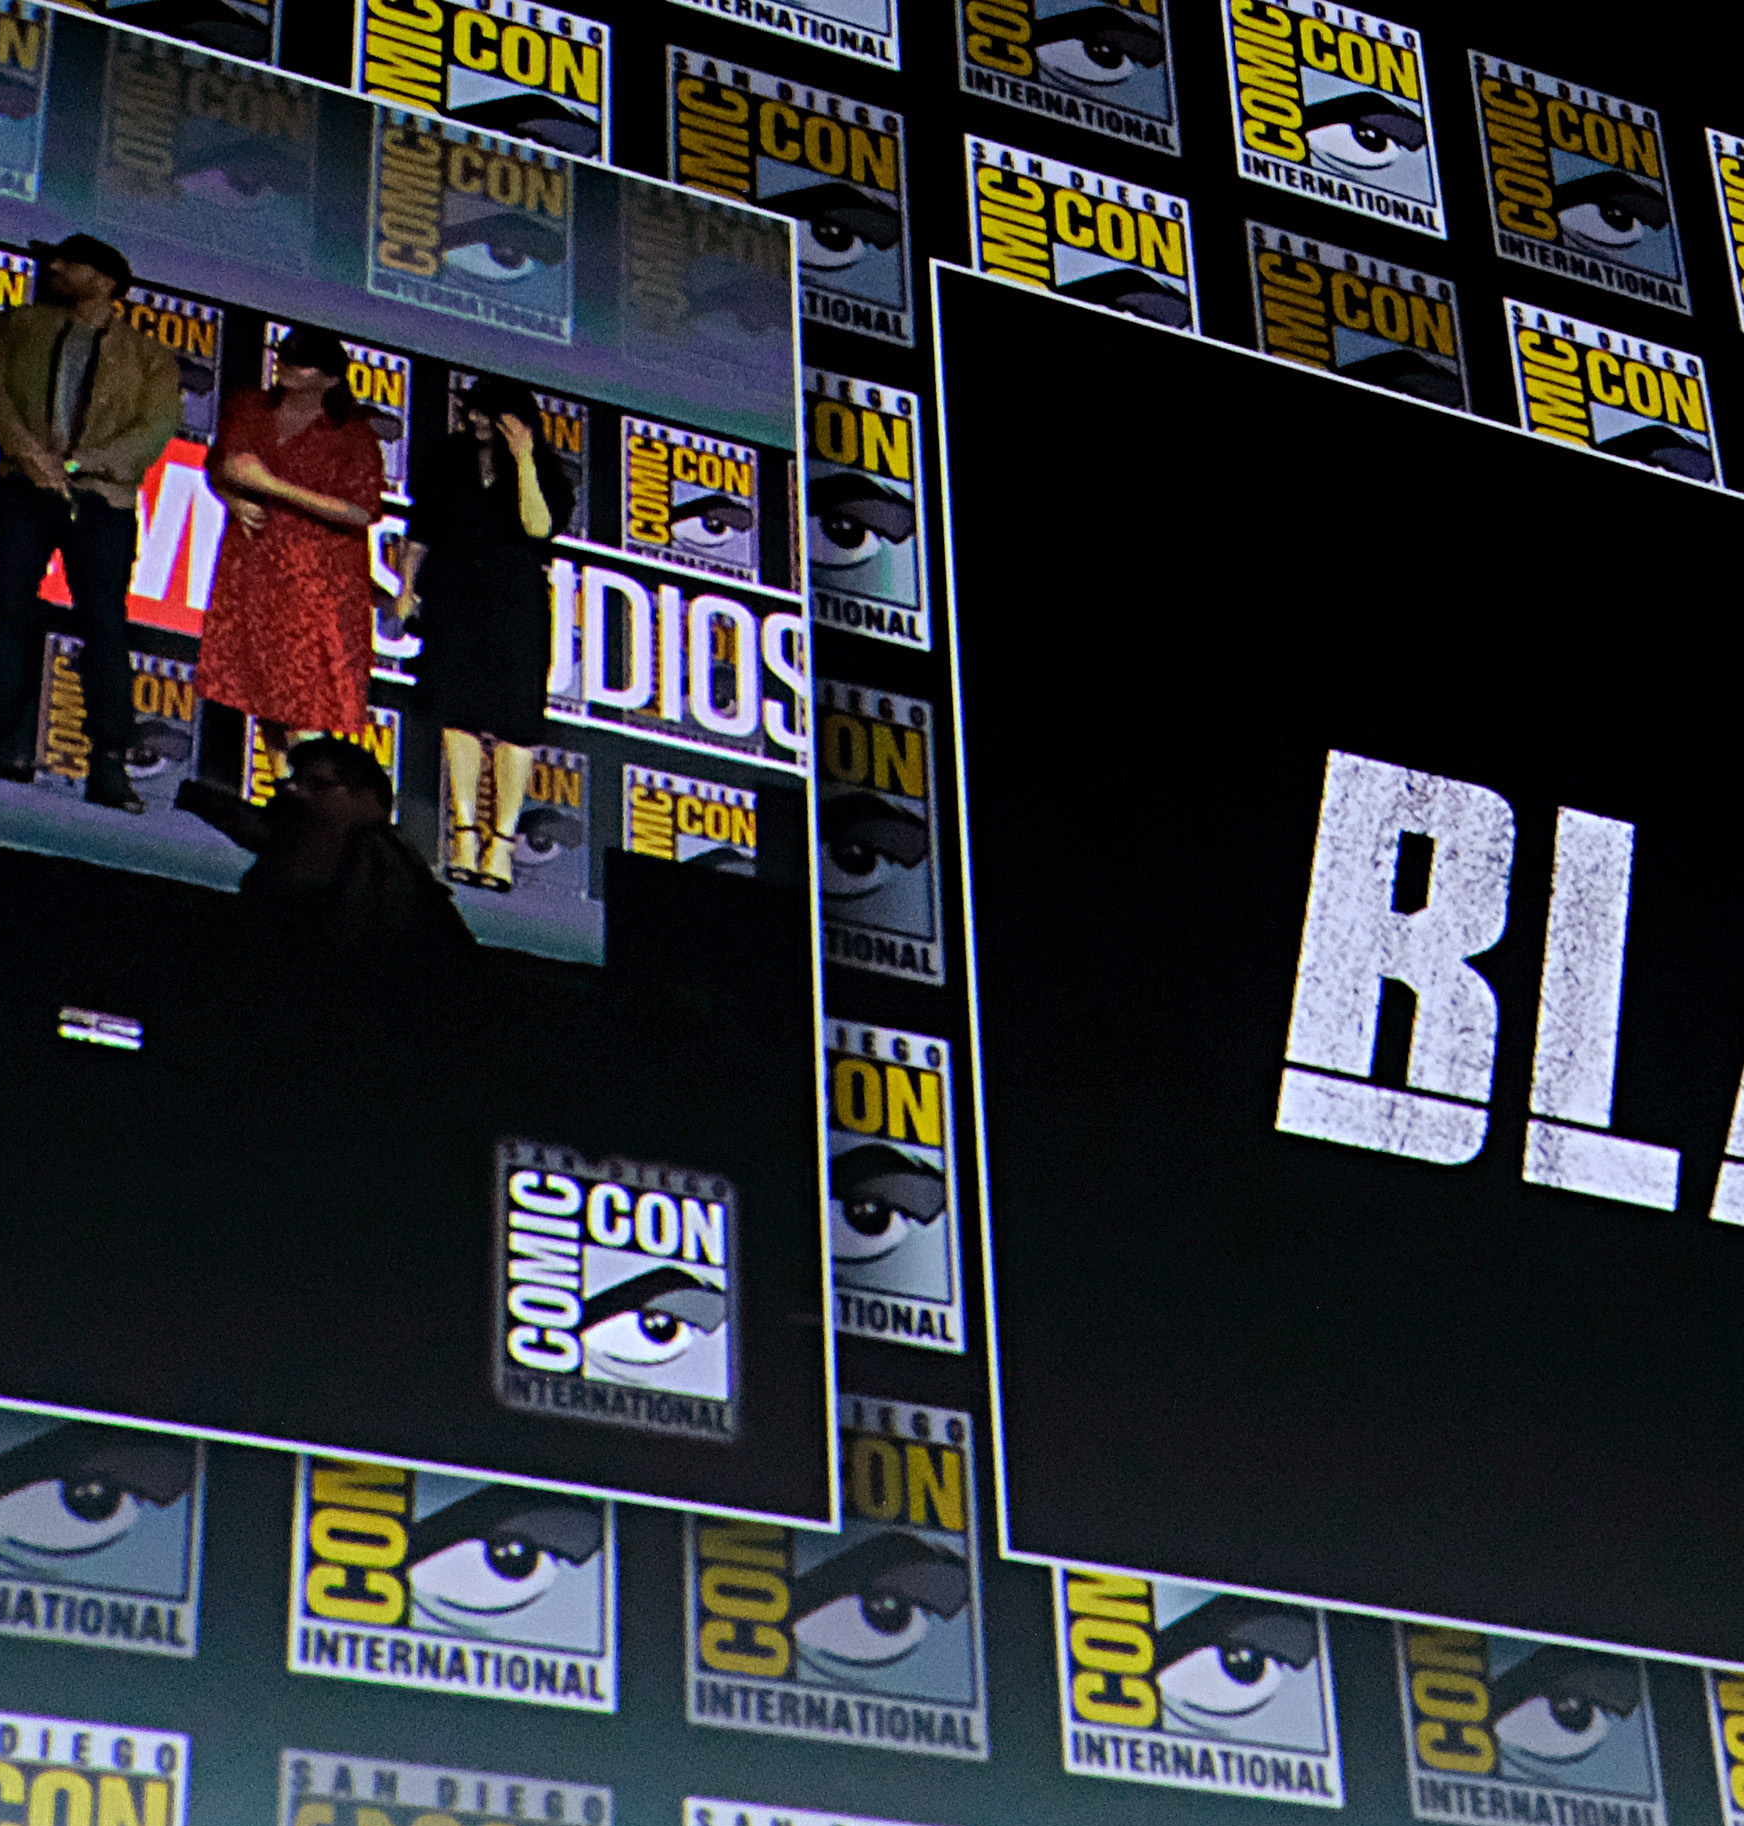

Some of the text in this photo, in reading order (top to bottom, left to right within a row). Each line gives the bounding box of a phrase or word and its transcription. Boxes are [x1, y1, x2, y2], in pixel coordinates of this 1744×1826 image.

[454, 11, 600, 105] CON
[1299, 16, 1419, 102] CON
[759, 101, 896, 193] CON
[971, 140, 1184, 221] SAN DIEGO
[1479, 76, 1561, 244] COMIC
[1544, 97, 1664, 182] CON
[377, 124, 446, 276] COMIC
[447, 148, 565, 218] CON
[1242, 154, 1442, 232] INTERNATIONAL
[1054, 188, 1185, 277] CON
[1499, 232, 1687, 310] INTERNATIONAL
[1586, 352, 1709, 434] CON
[628, 434, 669, 545] COMIC
[672, 447, 754, 499] CON
[586, 1181, 728, 1267] CON
[507, 1169, 584, 1374] COMIC
[506, 1372, 732, 1435] INTERNATIONAL
[299, 1627, 606, 1703] INTERNATIONAL
[1071, 1730, 1336, 1797] INTERNATIONAL
